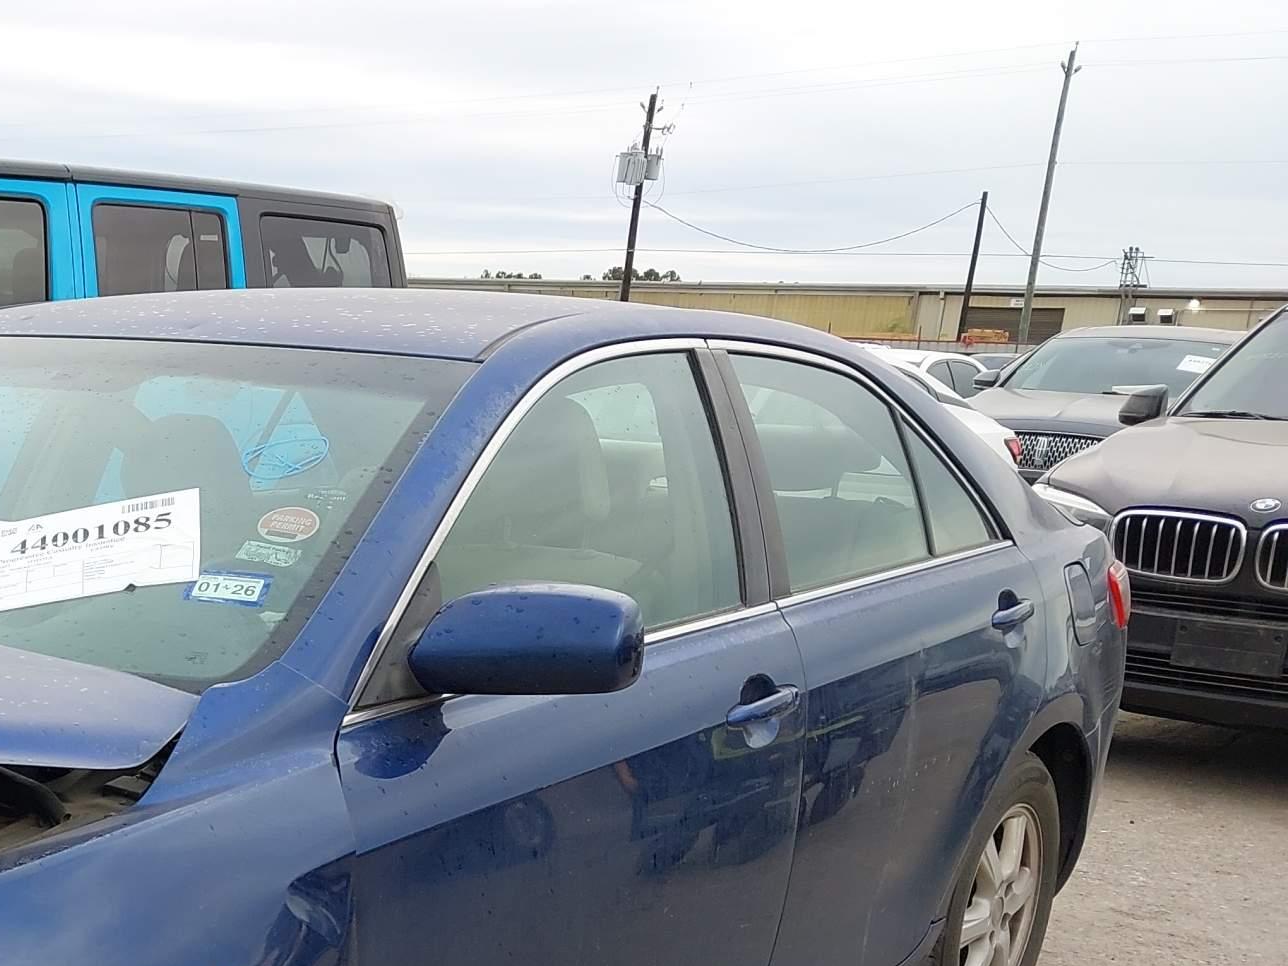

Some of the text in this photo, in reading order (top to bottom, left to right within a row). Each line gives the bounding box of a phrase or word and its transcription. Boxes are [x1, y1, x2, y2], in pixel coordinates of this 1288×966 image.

[269, 520, 306, 533] PERMIT
[271, 513, 313, 527] PARKING
[10, 511, 173, 555] 44001085
[197, 581, 257, 597] 01 26
